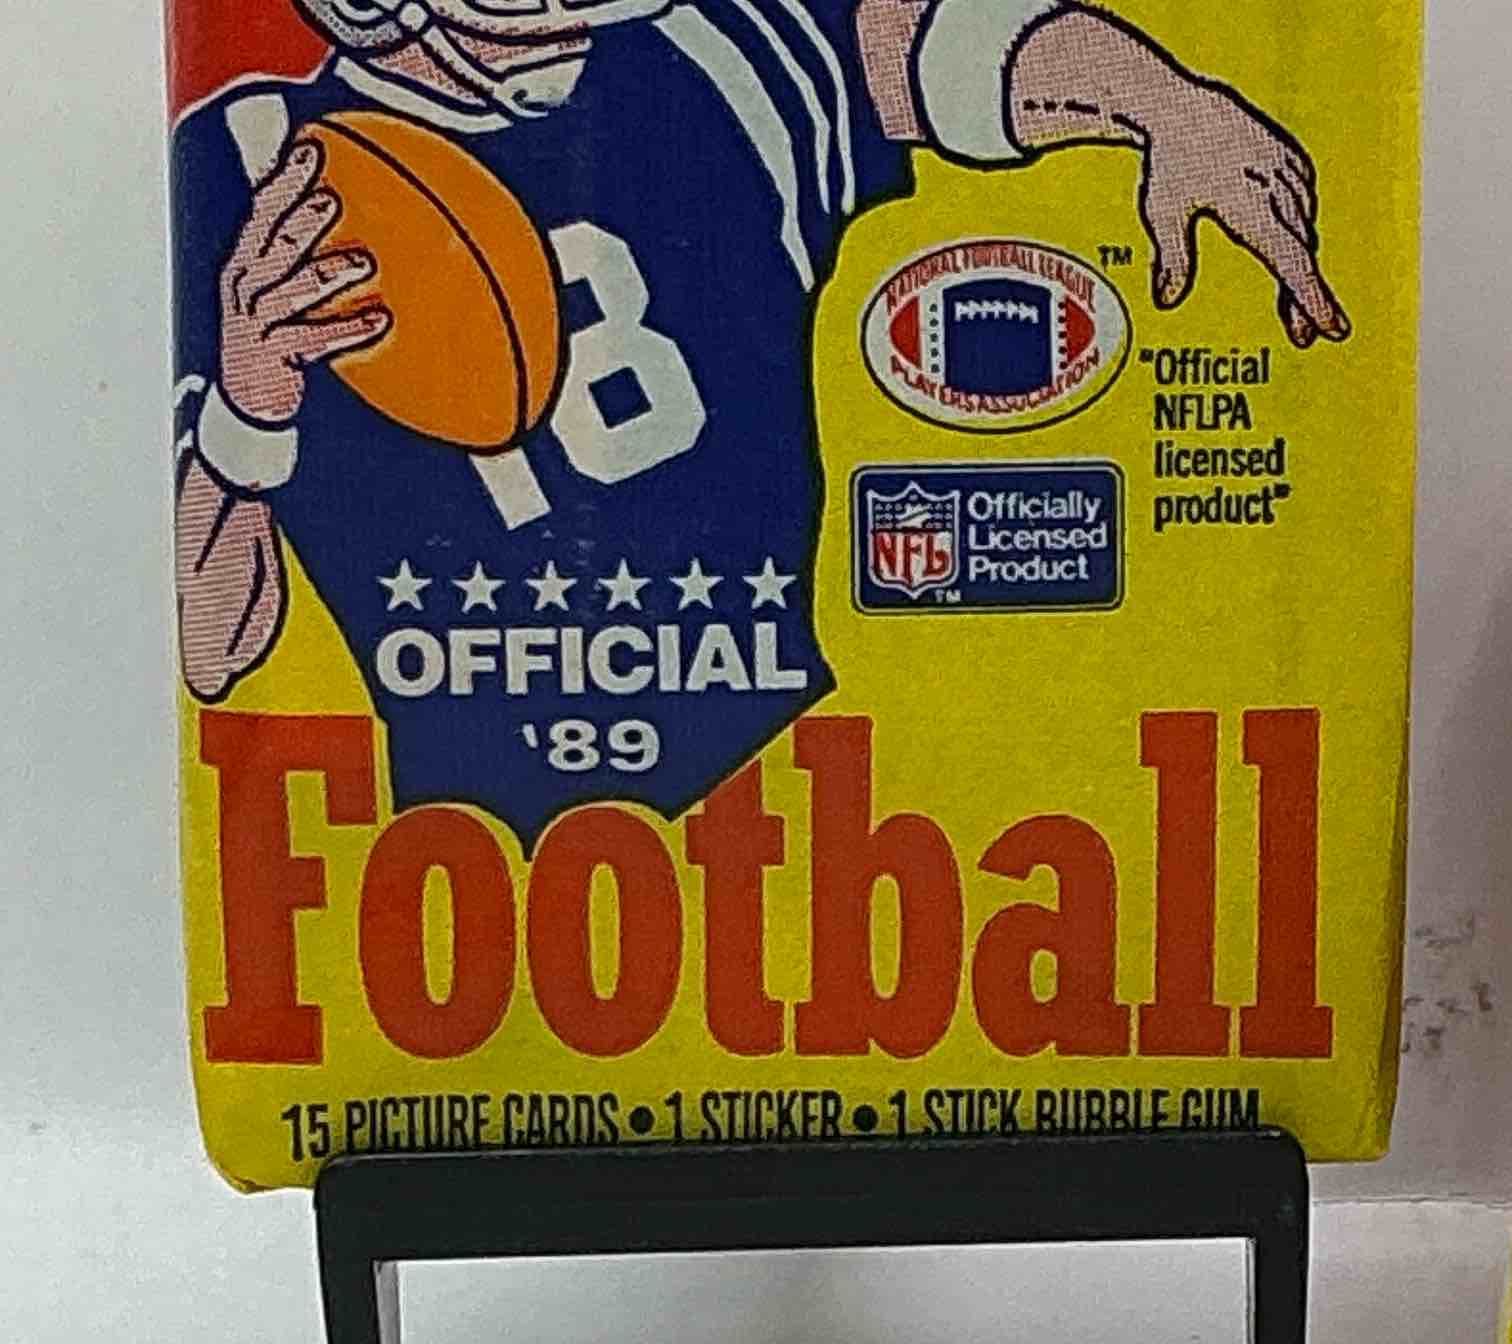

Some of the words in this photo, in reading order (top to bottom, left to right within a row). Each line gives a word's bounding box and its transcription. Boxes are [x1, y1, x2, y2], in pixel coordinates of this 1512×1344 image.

[886, 247, 962, 313] NATIONAL
[1139, 347, 1270, 386] "Official
[1154, 393, 1251, 431] NFLPA
[1154, 437, 1286, 478] licensed
[967, 490, 1102, 524] Officially
[1154, 484, 1292, 532] product"
[871, 530, 953, 587] NFL
[968, 522, 1107, 552] Licensed
[968, 554, 1090, 583] Product
[376, 621, 808, 697] OFFICIAL
[523, 718, 661, 773] '89
[200, 708, 1334, 1065] Football
[280, 1102, 331, 1161] 15
[345, 1093, 490, 1154] PICTURE
[502, 1091, 620, 1147] CARDS
[665, 1089, 686, 1144] 1
[700, 1088, 844, 1142] STICKER
[888, 1088, 908, 1141] 1
[924, 1087, 1021, 1136] STICK
[1035, 1087, 1169, 1134] BUBBLE
[1181, 1087, 1260, 1131] GUM
